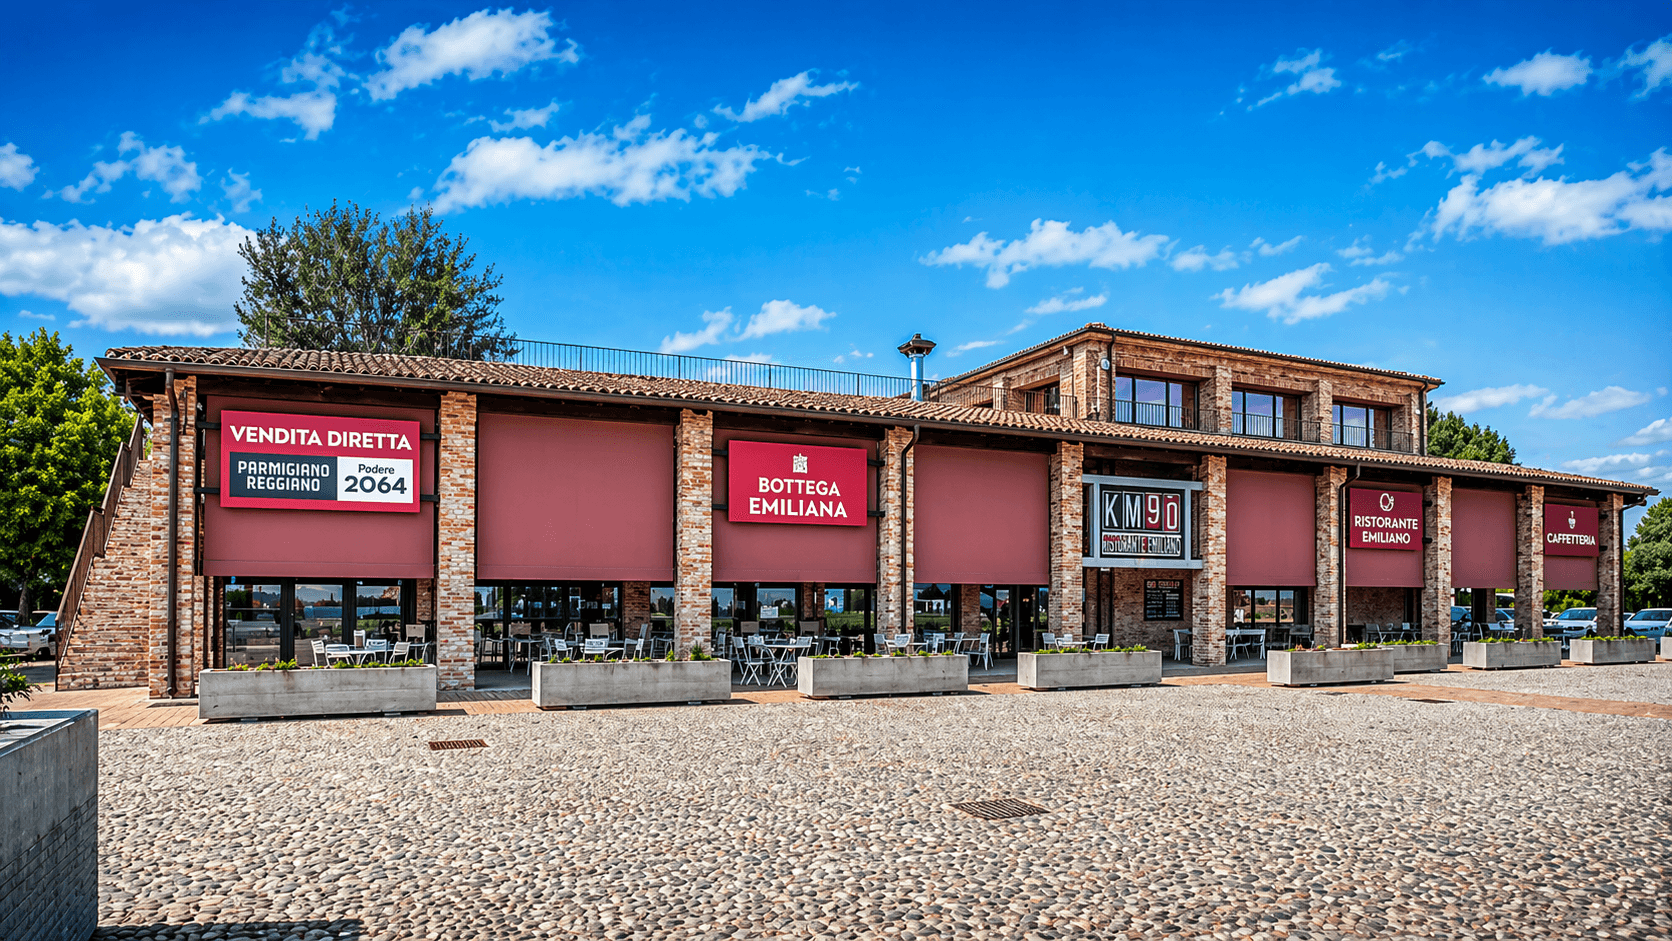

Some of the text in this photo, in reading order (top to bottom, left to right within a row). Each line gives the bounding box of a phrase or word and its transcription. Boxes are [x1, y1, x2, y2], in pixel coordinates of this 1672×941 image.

[230, 425, 412, 450] VENDITA DIRETTA
[238, 460, 330, 478] PARMIGIANO
[358, 464, 395, 475] Podere
[246, 476, 321, 492] REGGIANO
[344, 475, 407, 494] 2064
[758, 476, 841, 497] BOTTEGA
[749, 497, 848, 518] EMILIANA
[1354, 515, 1419, 530] RISTORANTE
[1102, 535, 1181, 555] RISTORANTE EMILIANO
[1362, 531, 1411, 545] EMILIANO
[1546, 533, 1596, 546] CAFFETTERIA
